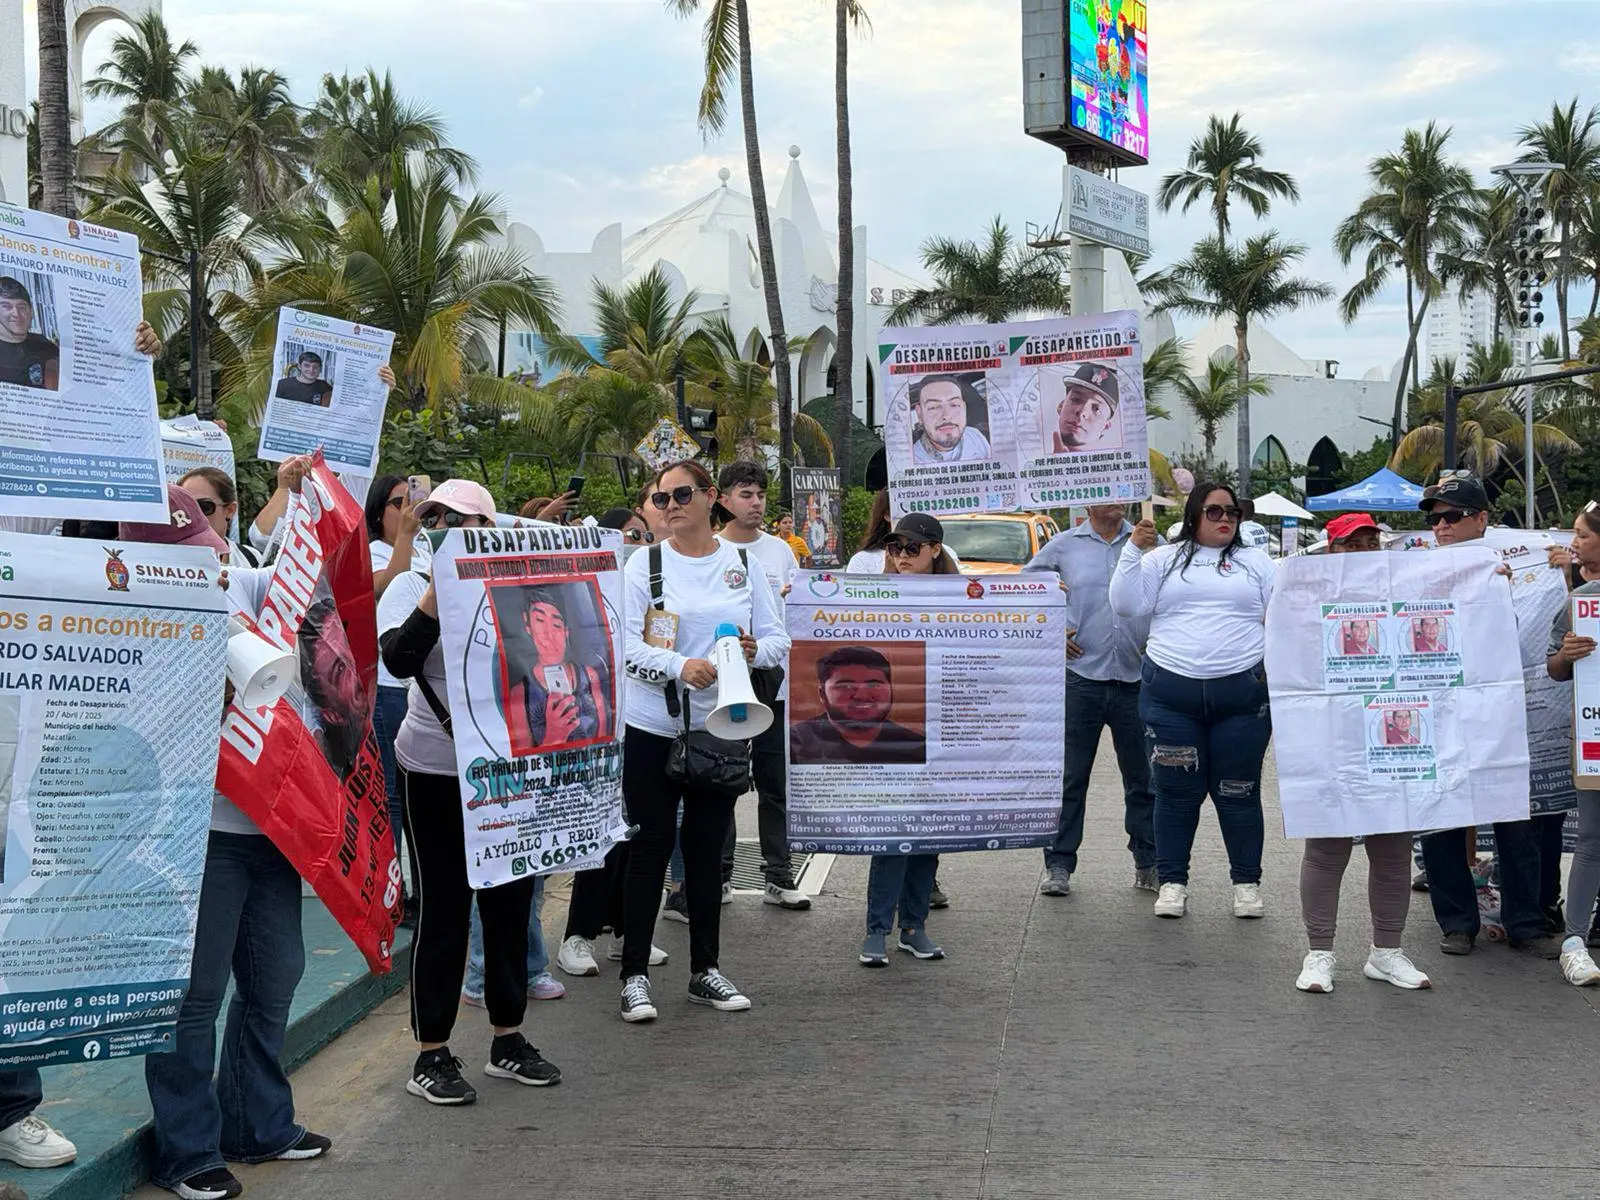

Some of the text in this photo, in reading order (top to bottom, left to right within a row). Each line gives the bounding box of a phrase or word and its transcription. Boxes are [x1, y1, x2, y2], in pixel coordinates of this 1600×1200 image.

[83, 225, 118, 239] SINALOA
[41, 246, 48, 256] a
[53, 248, 110, 270] encontrar
[114, 263, 122, 272] a
[47, 263, 93, 281] MARTINEZ
[96, 274, 128, 288] VALDEZ
[1026, 332, 1120, 355] DESAPARECIDO
[896, 346, 990, 363] DESAPARECIDO
[2, 452, 46, 462] información
[51, 455, 86, 465] referente
[99, 460, 117, 468] esta
[1047, 457, 1070, 465] PRIVADO
[1089, 453, 1114, 462] LIBERTAD
[39, 465, 48, 474] Tu
[52, 467, 77, 476] ayuda
[91, 470, 107, 480] muy
[110, 470, 156, 480] importante.
[916, 467, 939, 475] PRIVADO
[958, 464, 983, 472] LIBERTAD
[1020, 470, 1027, 478] DE
[1029, 469, 1052, 477] FEBRERO
[1066, 466, 1080, 475] 2025
[795, 475, 839, 490] CARNIVAL
[899, 479, 922, 487] FEBRERO
[935, 477, 950, 485] 2025
[1041, 486, 1110, 501] 6693262089
[173, 510, 191, 528] R
[464, 527, 601, 553] DESAPARECIDO
[135, 564, 208, 580] SINALOA
[137, 578, 171, 587] GOBIERNO
[845, 588, 899, 599] Sinaloa
[813, 609, 1047, 625] Ayúdanos a encontrar a
[1334, 606, 1380, 614] DESAPARECIDO
[38, 615, 52, 631] a
[62, 616, 186, 640] encontrar
[191, 624, 204, 640] a
[814, 628, 1043, 639] OSCAR DAVID ARAMBURO SAINZ
[43, 645, 143, 666] SALVADOR
[49, 674, 131, 693] MADERA
[46, 699, 68, 708] Fecha
[80, 700, 129, 709] Desaparición:
[46, 711, 55, 719] 20
[45, 722, 81, 731] Municipio
[63, 745, 92, 753] Hombre
[41, 756, 61, 764] Edad:
[472, 756, 554, 779] FUE PRIVADO DE SU
[790, 814, 801, 822] Si
[847, 814, 915, 823] información
[921, 814, 971, 822] referente
[790, 824, 821, 833] llama
[905, 824, 918, 832] Tu
[922, 824, 955, 832] ayuda
[335, 812, 361, 878] JUAN
[552, 834, 559, 846] A
[3, 998, 68, 1015] referente
[74, 996, 83, 1008] a
[89, 992, 120, 1007] esta
[3, 1004, 178, 1038] ayuda es muy importante.
